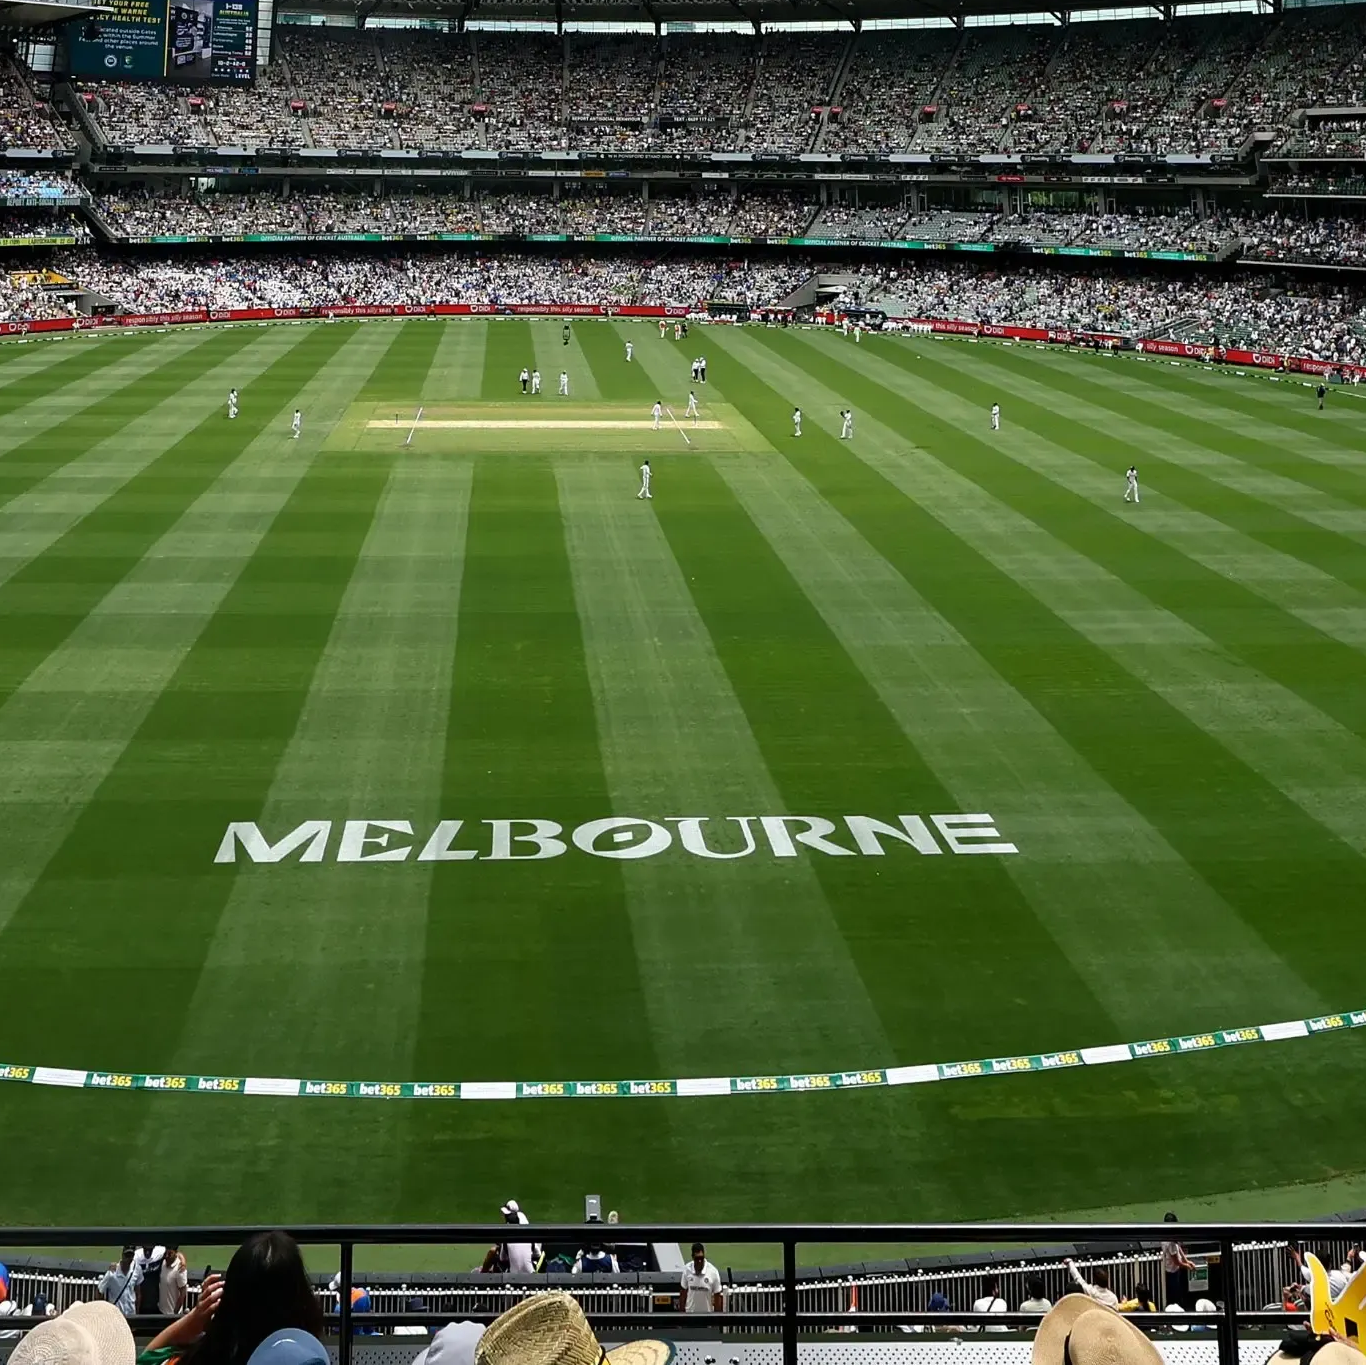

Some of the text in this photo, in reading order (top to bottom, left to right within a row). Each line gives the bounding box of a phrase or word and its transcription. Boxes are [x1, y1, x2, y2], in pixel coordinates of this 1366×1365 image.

[112, 14, 161, 24] HEALTH TEST
[120, 8, 148, 16] WARNE
[1159, 344, 1179, 353] season
[213, 813, 1019, 863] MELBOURNE
[1309, 1015, 1343, 1031] bet365
[1223, 1027, 1259, 1043] bet365
[1134, 1041, 1171, 1055] bet365
[1040, 1052, 1079, 1066] bet365
[941, 1061, 982, 1075] bet365
[91, 1072, 133, 1087] bet365
[198, 1077, 240, 1090] bet365
[736, 1076, 778, 1090] bet365
[841, 1071, 882, 1086] bet365
[305, 1082, 347, 1095] bet365
[413, 1083, 455, 1097] bet365
[522, 1082, 564, 1095] bet365
[629, 1080, 671, 1094] bet365
